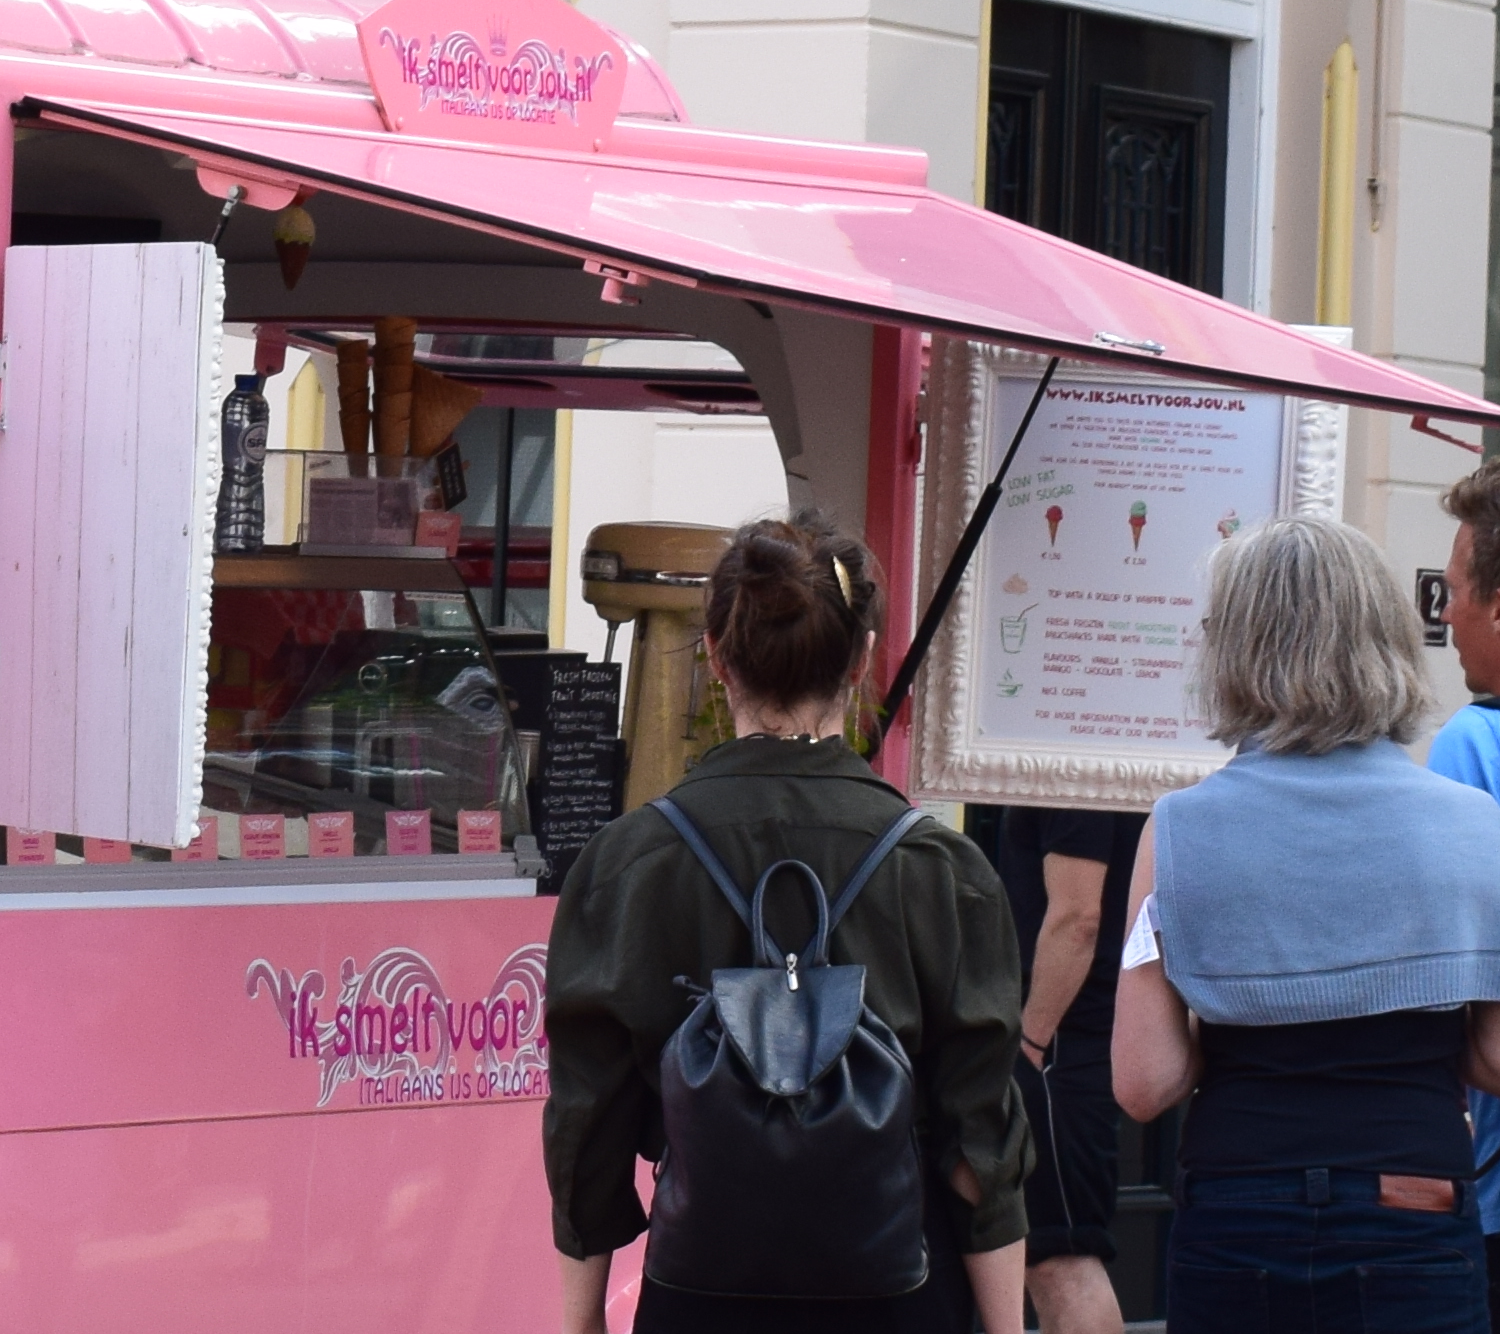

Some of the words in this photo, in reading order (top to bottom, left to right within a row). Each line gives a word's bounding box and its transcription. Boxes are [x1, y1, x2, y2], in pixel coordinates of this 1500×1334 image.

[427, 54, 482, 90] smelt
[489, 65, 532, 97] voor
[1046, 387, 1246, 412] WWW.IKSMELTVOORJOU.NL
[1006, 490, 1031, 508] LOW
[1036, 484, 1076, 502] SUGAR
[1008, 475, 1032, 490] LOW
[1038, 469, 1056, 483] FAT
[1430, 581, 1442, 619] 2
[288, 990, 320, 1058] ik
[335, 988, 434, 1055] smelt
[447, 996, 528, 1052] voor
[360, 1072, 444, 1104] ITALIAANS
[450, 1072, 472, 1101] IJS
[477, 1071, 499, 1099] OP
